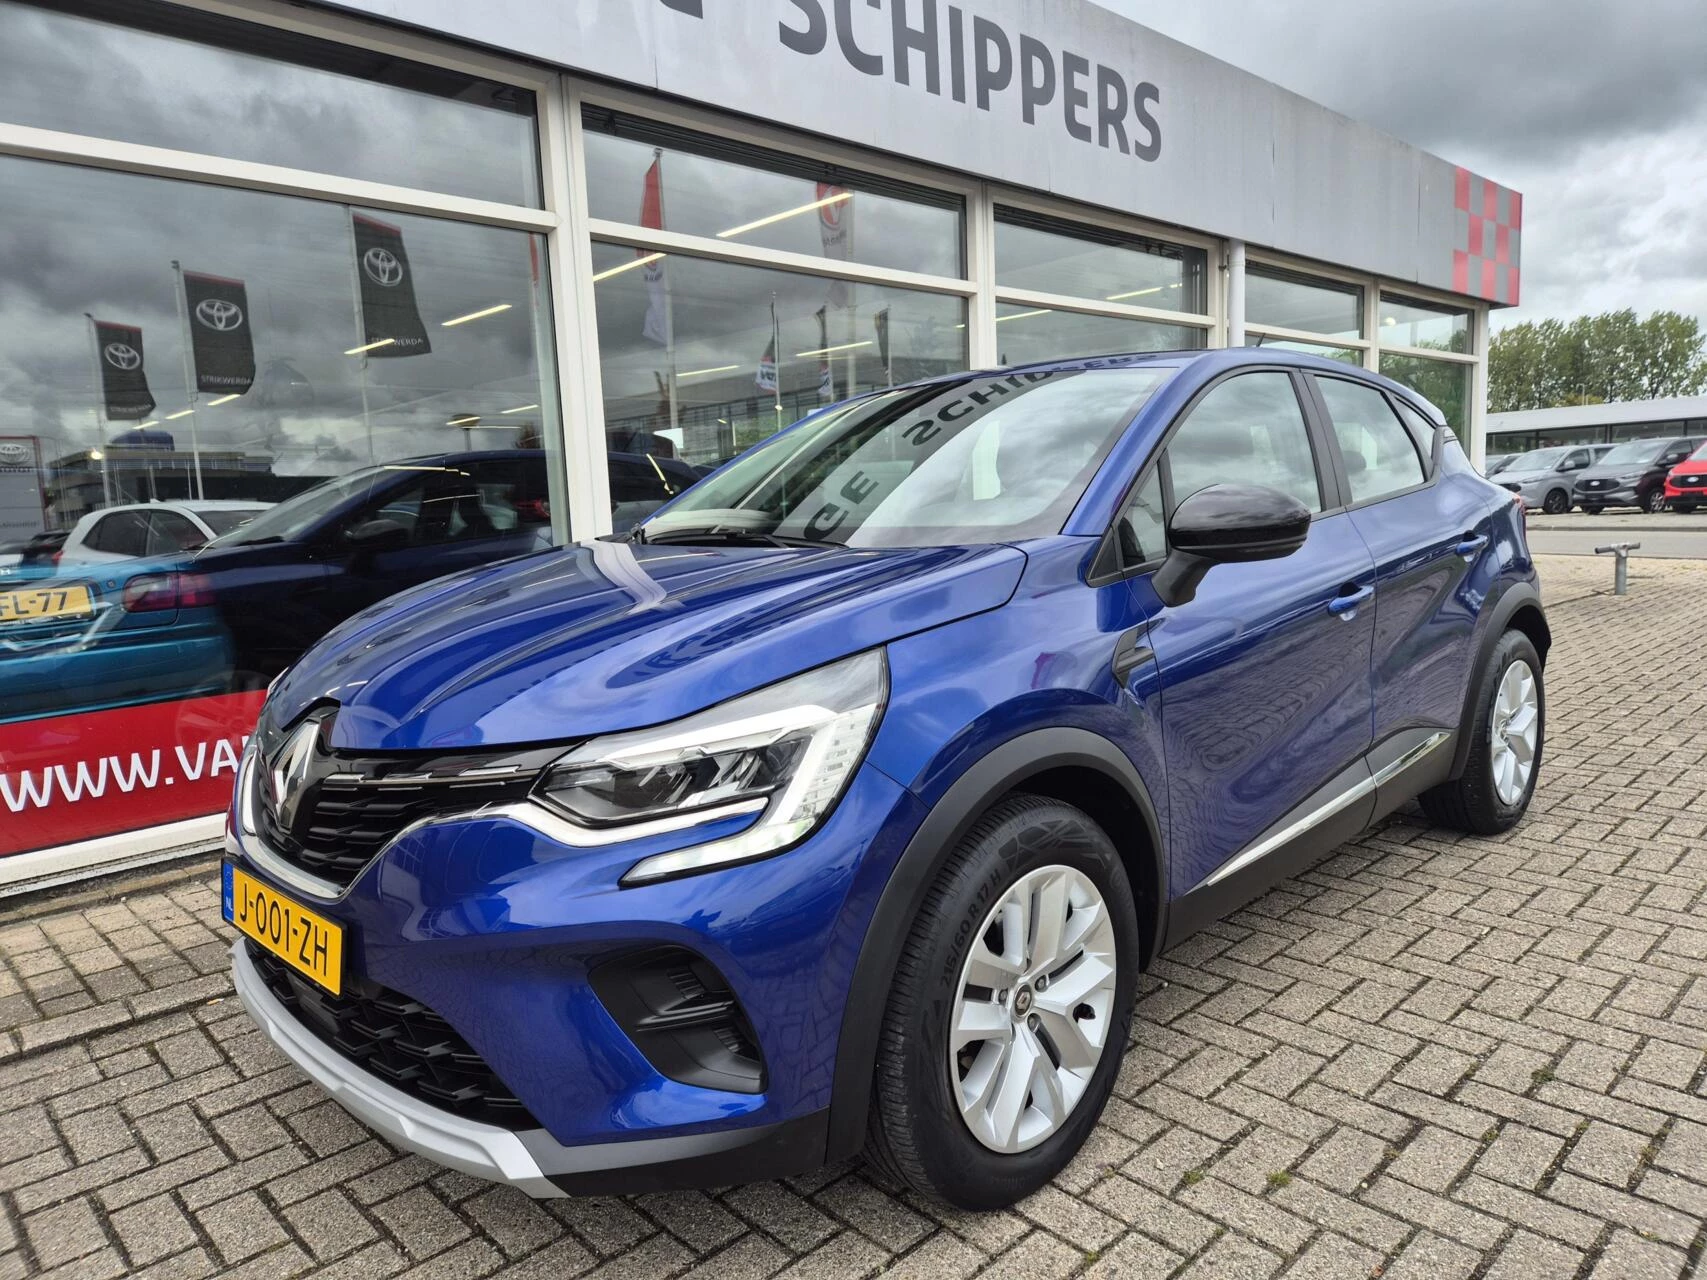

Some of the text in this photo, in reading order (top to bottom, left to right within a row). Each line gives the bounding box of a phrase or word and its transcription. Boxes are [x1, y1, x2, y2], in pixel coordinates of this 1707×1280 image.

[778, 0, 1163, 163] SCHIPPERS
[0, 735, 249, 812] WWW.VA
[240, 882, 329, 977] J-001-ZH
